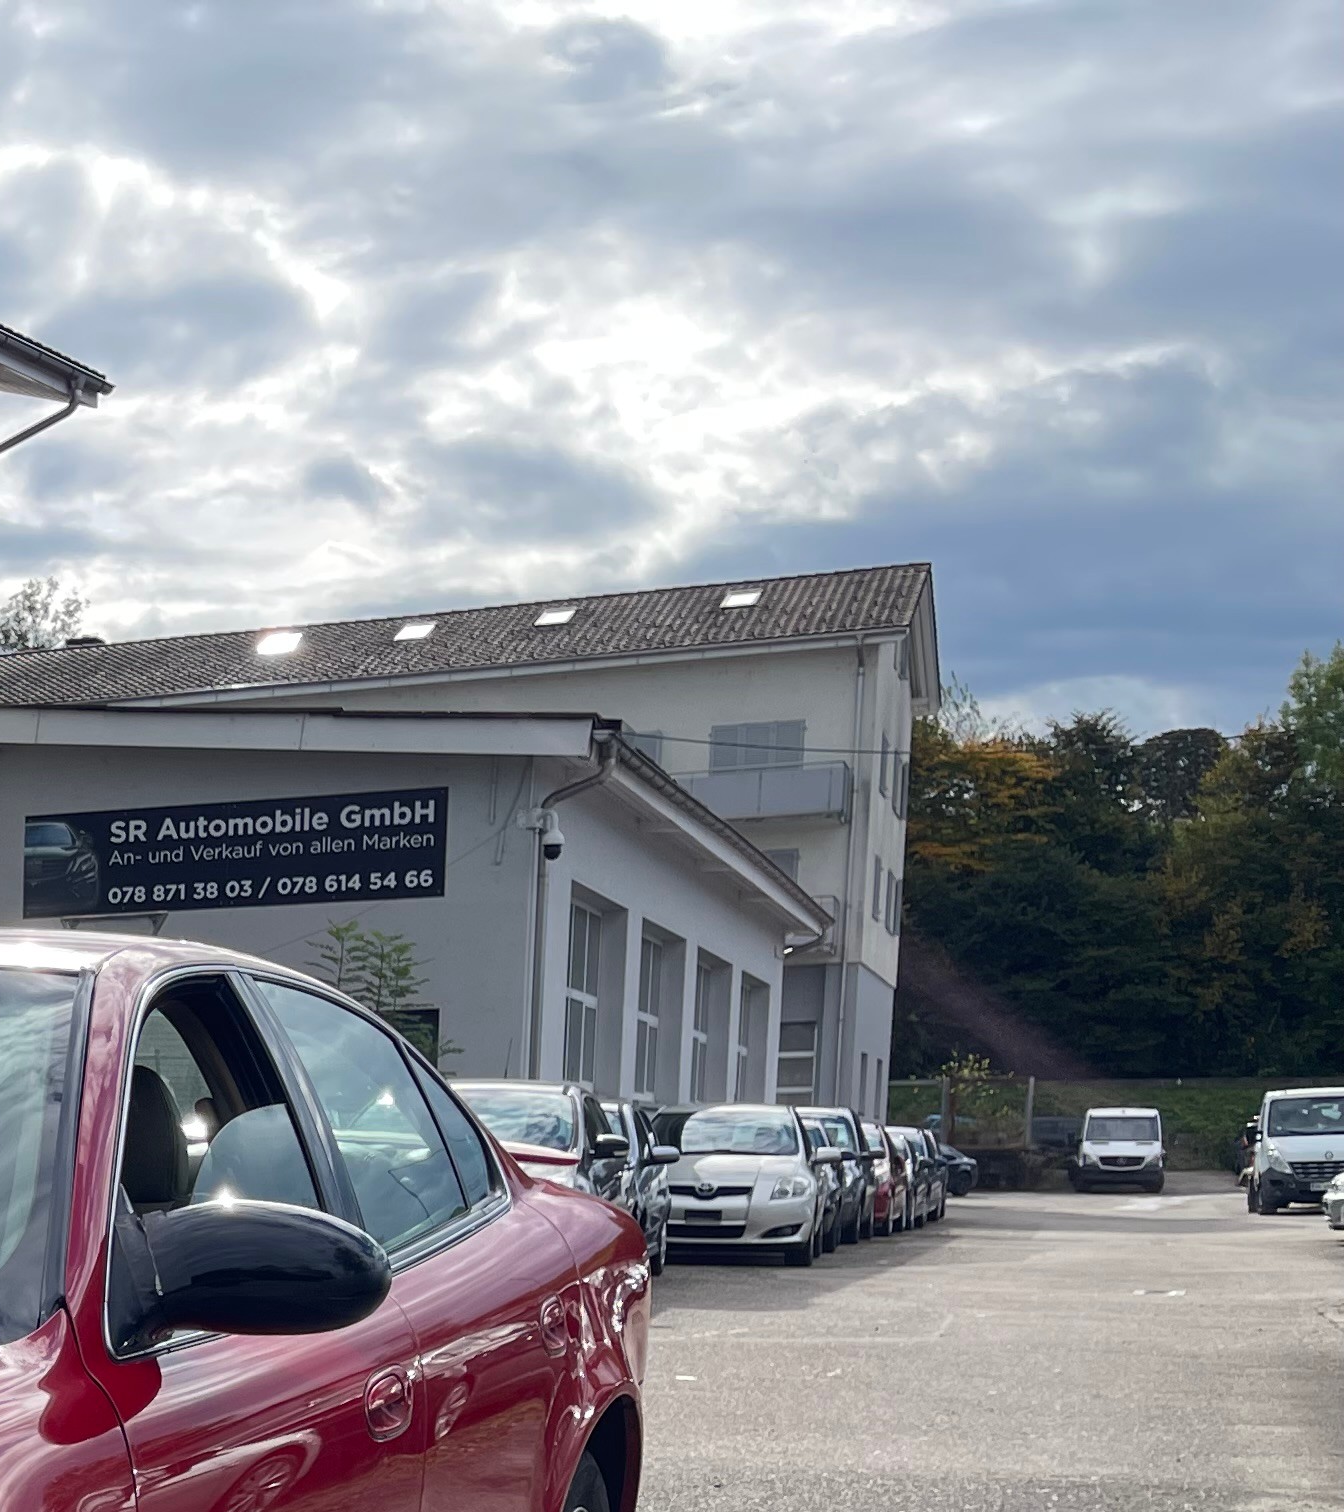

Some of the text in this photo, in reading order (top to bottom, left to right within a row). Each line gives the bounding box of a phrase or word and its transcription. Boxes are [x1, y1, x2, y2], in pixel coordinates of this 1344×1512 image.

[109, 799, 435, 844] SR Automobile GmbH
[108, 832, 435, 866] An- und Verkauf von allen Marken
[107, 869, 434, 904] 078 871 38 03 / 078 614 54 66
